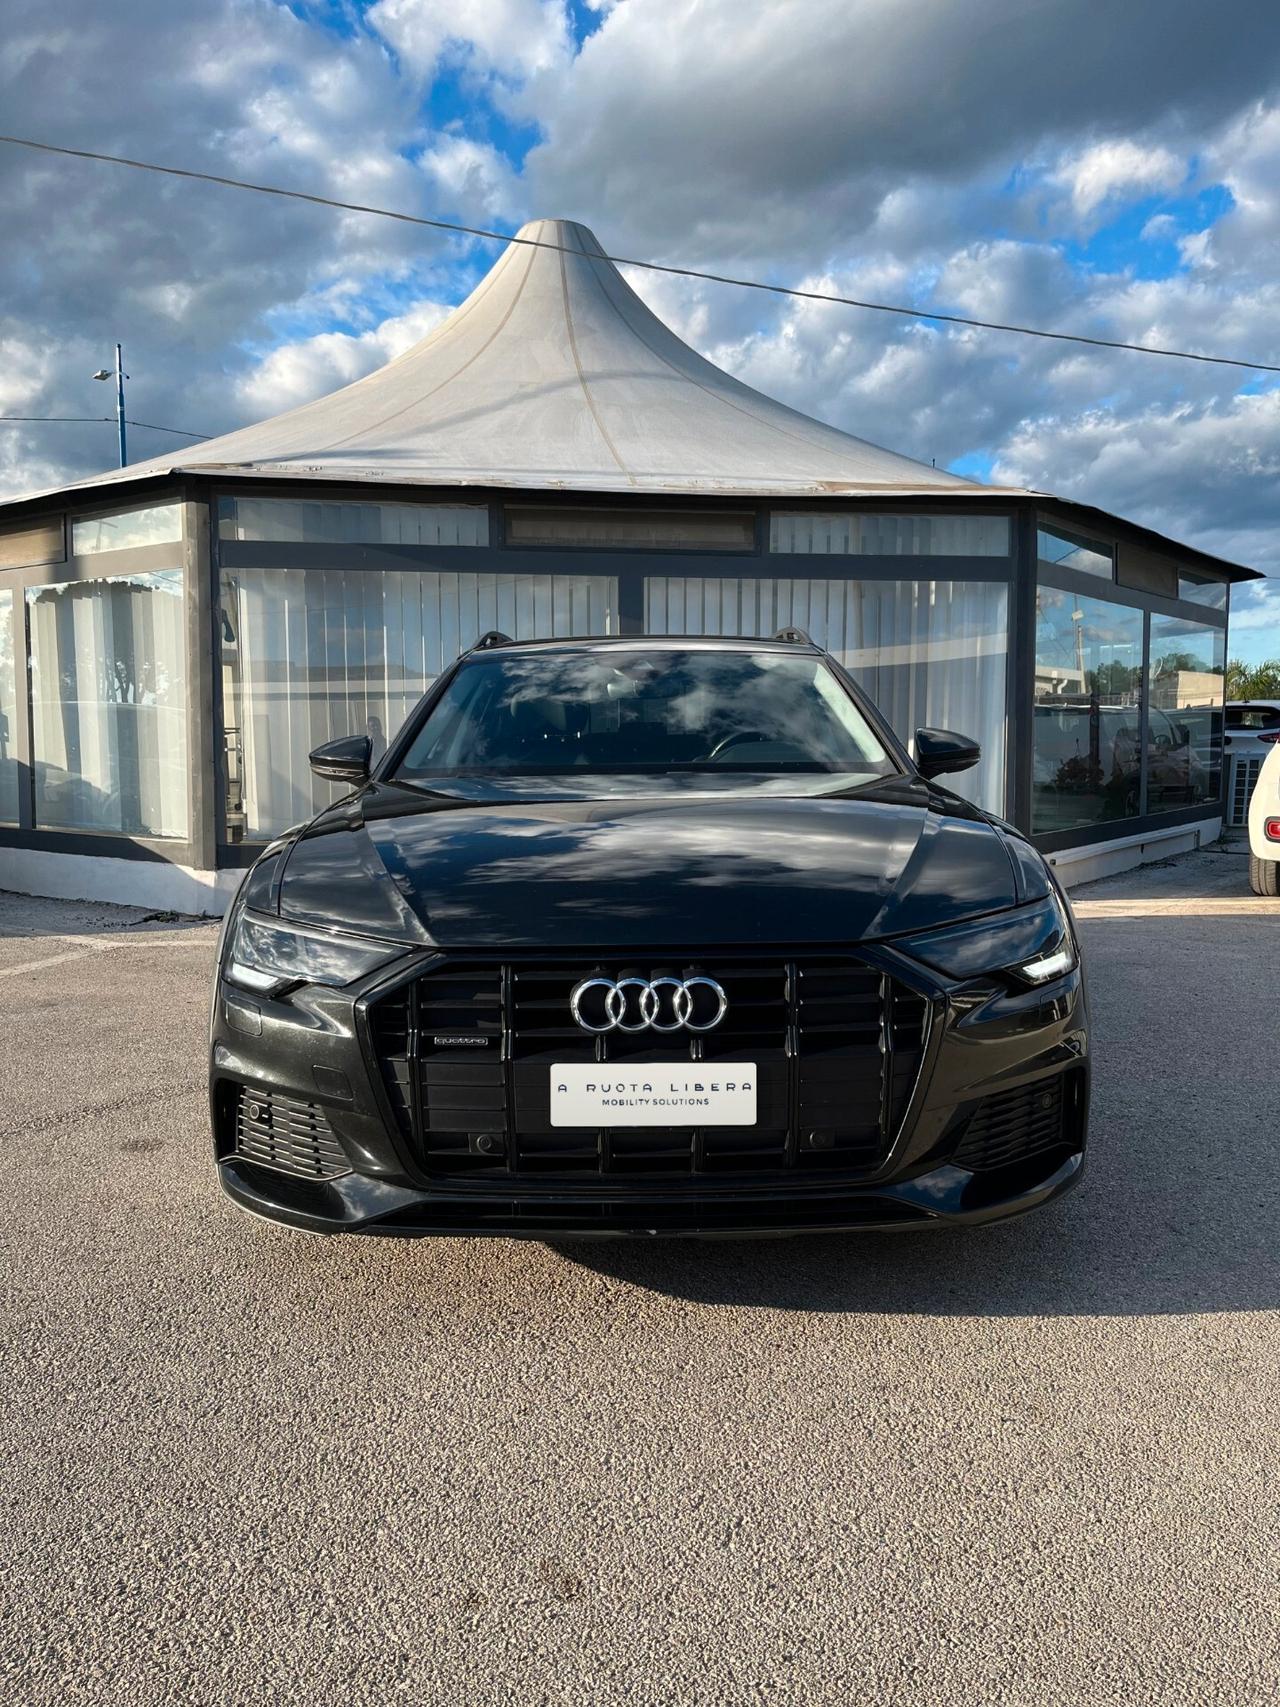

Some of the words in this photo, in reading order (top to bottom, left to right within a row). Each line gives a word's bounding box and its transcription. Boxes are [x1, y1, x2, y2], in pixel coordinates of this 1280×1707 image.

[558, 1084, 567, 1092] A
[586, 1083, 652, 1092] RUOTA
[670, 1083, 751, 1092] LIBERA
